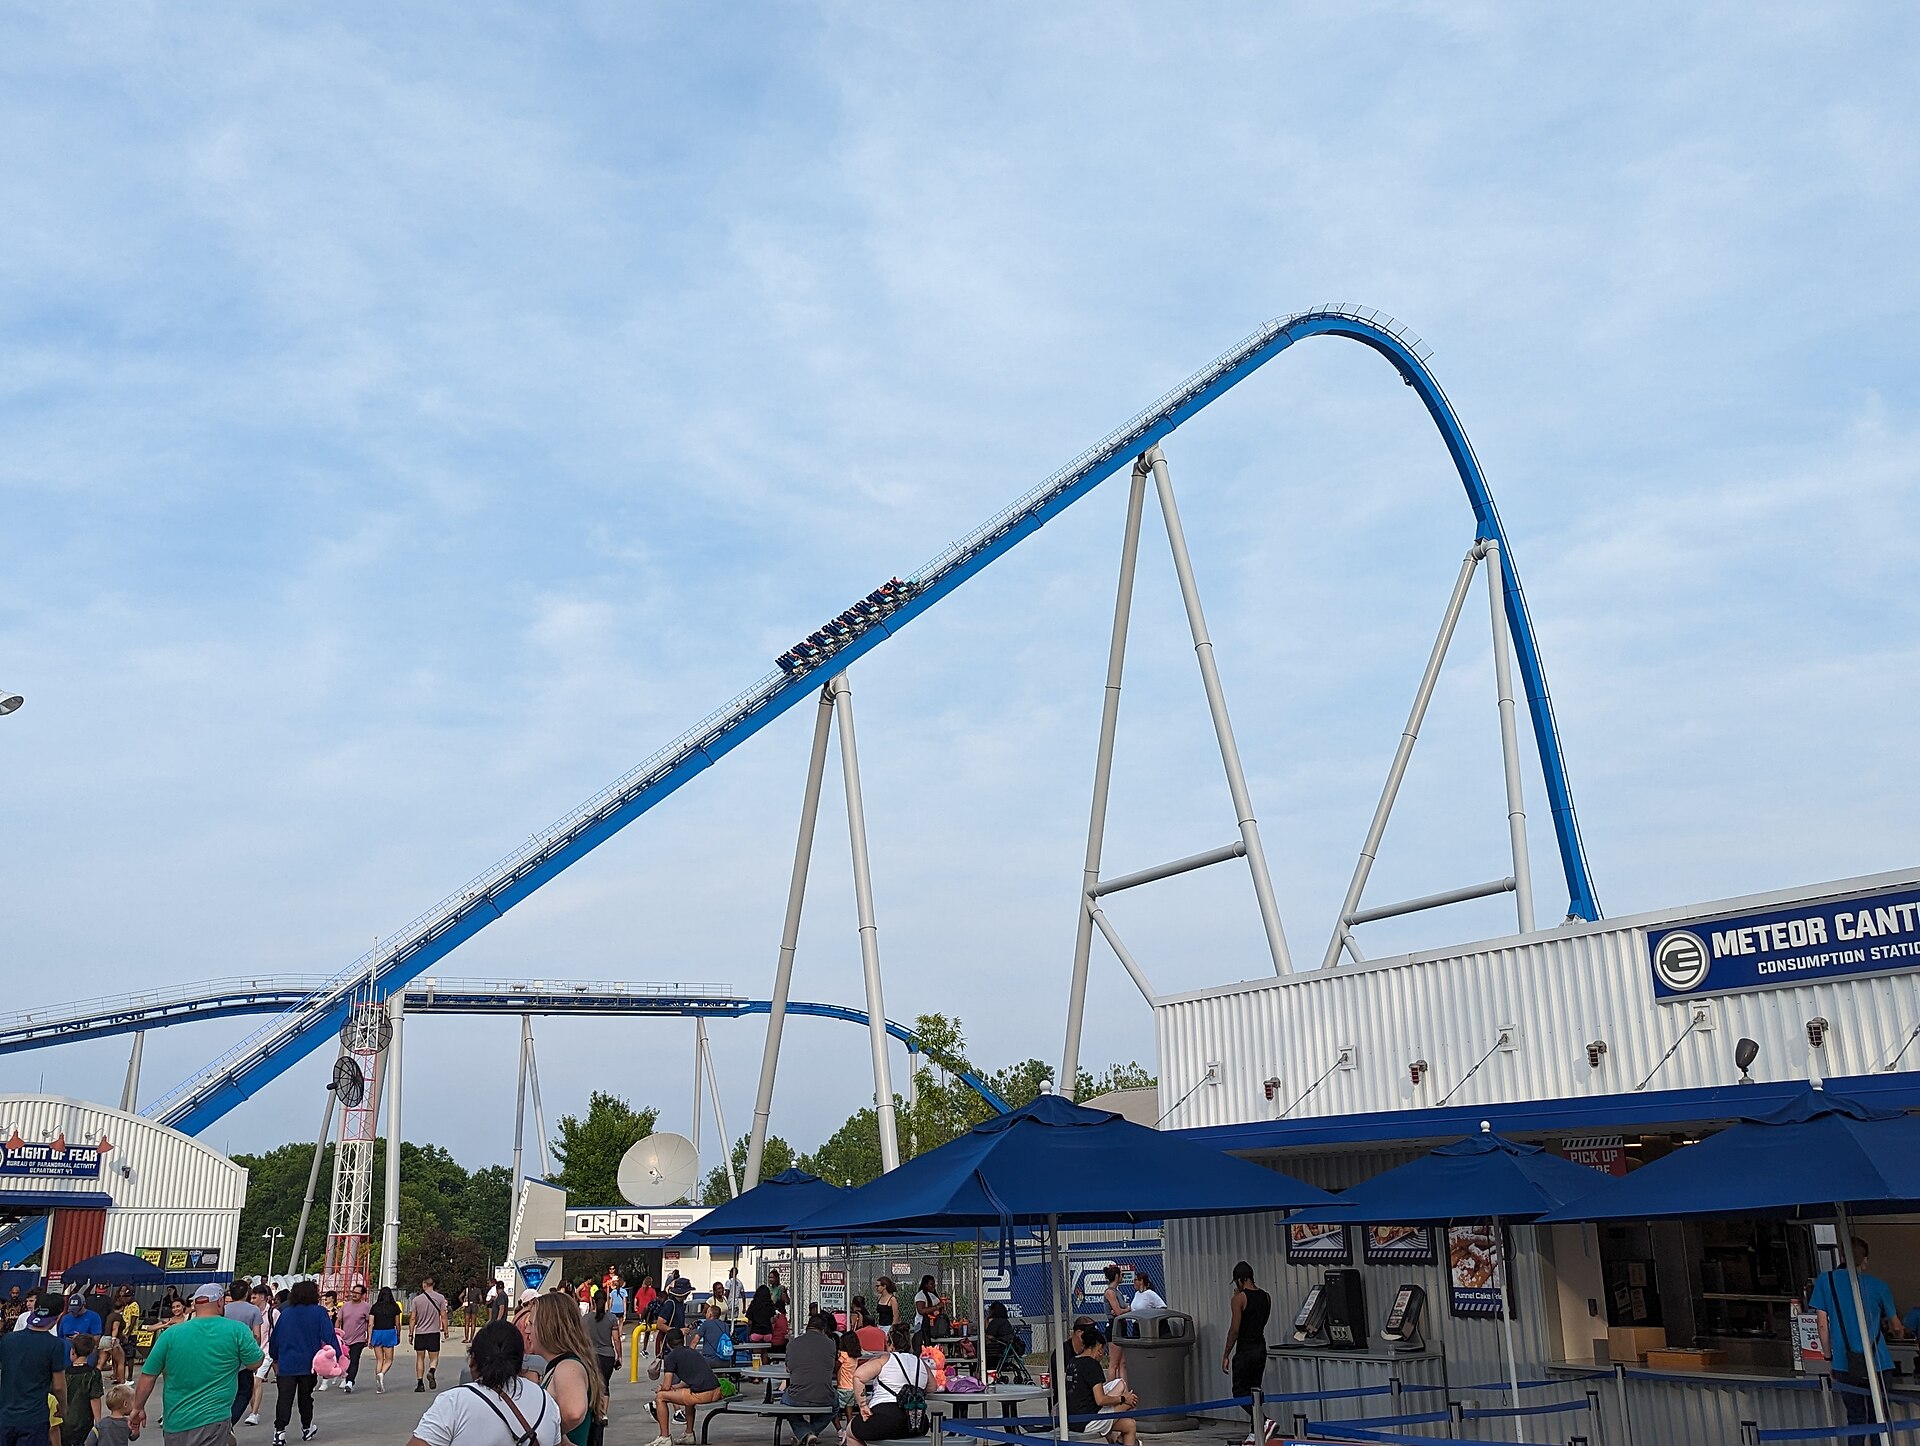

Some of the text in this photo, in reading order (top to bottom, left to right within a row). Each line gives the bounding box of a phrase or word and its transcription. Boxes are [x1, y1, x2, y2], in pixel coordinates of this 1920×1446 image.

[1711, 916, 1828, 959] METEOR
[1757, 948, 1865, 975] CONSUMPTION
[7, 1146, 49, 1159] FLIGHT
[69, 1149, 98, 1161] FEAR
[1570, 1150, 1618, 1163] PICK UP
[37, 1161, 72, 1169] PARANORMAL
[576, 1210, 650, 1235] ORION
[821, 1272, 844, 1280] ATTENTION
[1454, 1291, 1475, 1299] Funnel
